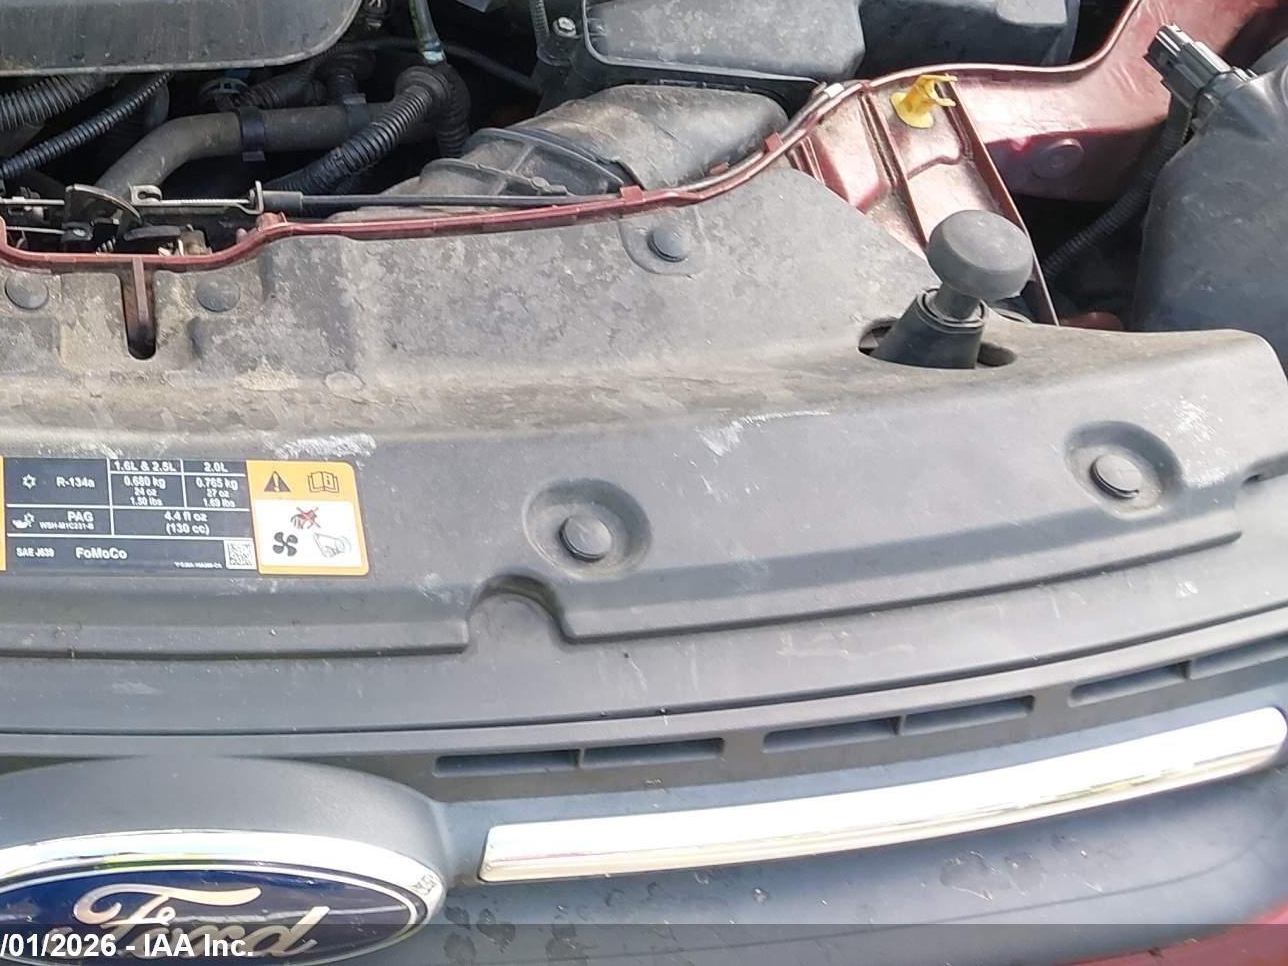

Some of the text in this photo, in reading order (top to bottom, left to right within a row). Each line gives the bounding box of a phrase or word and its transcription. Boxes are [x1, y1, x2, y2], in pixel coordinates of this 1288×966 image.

[114, 460, 138, 471] 1.6L
[152, 461, 177, 472] 2.5L
[203, 461, 228, 472] 2.0L
[56, 476, 95, 488] R-134a
[152, 475, 166, 489] kg
[195, 477, 238, 490] 0.765 kg
[146, 488, 157, 496] oz
[206, 488, 229, 498] 27 oz
[149, 496, 163, 506] lbs
[222, 498, 236, 508] lbs
[67, 510, 94, 522] PAG
[164, 510, 182, 521] 4.4
[193, 513, 208, 522] oz
[165, 522, 210, 535] (130 cc)
[16, 547, 34, 557] SAE
[75, 546, 128, 559] FoMoCo
[43, 883, 330, 959] Ford
